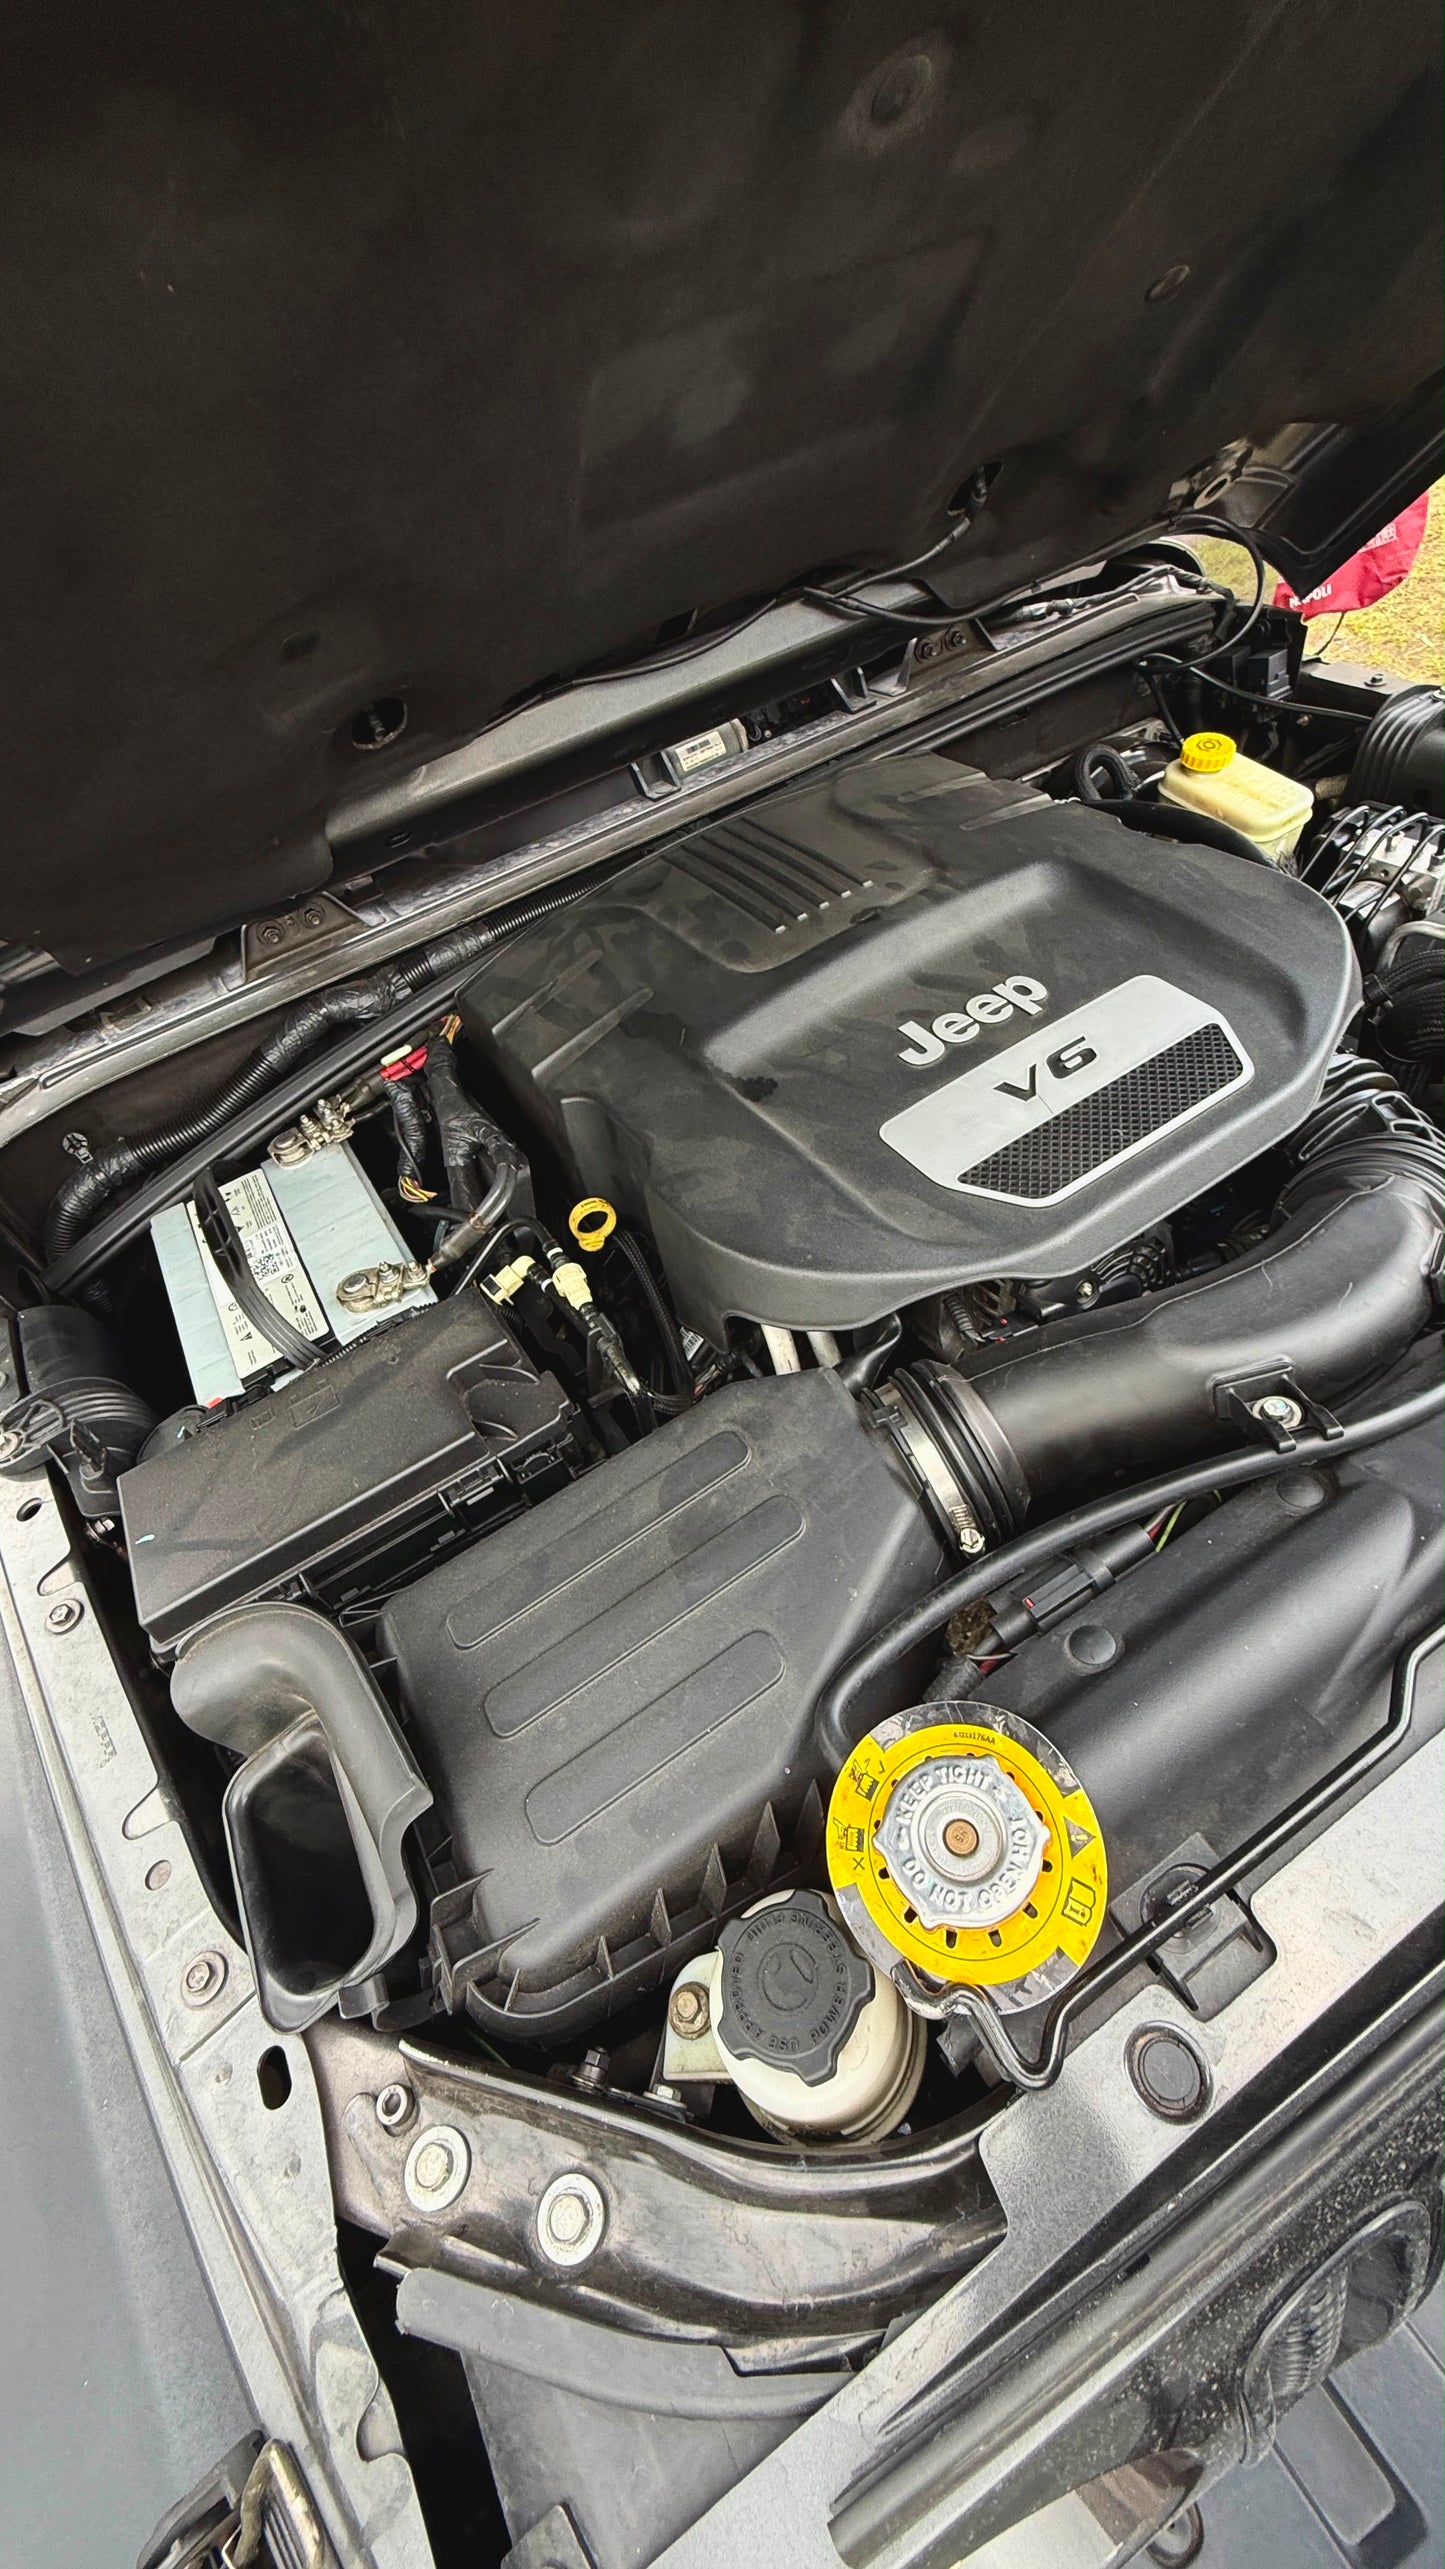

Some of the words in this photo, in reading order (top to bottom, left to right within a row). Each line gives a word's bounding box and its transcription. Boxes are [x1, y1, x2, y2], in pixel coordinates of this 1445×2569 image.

[1289, 583, 1332, 609] NPOLI
[897, 975, 1048, 1066] Jeep
[993, 1035, 1098, 1102] V6
[896, 1773, 934, 1825] KEEP
[935, 1765, 993, 1790] TIGHT
[903, 1858, 927, 1889] DO
[929, 1883, 973, 1913] NOT
[747, 1912, 785, 1942] FLUID
[790, 1913, 847, 1975] STEERING
[731, 1952, 765, 2038] APPROVED
[810, 1981, 847, 2045] POWER
[768, 2035, 800, 2052] USE
